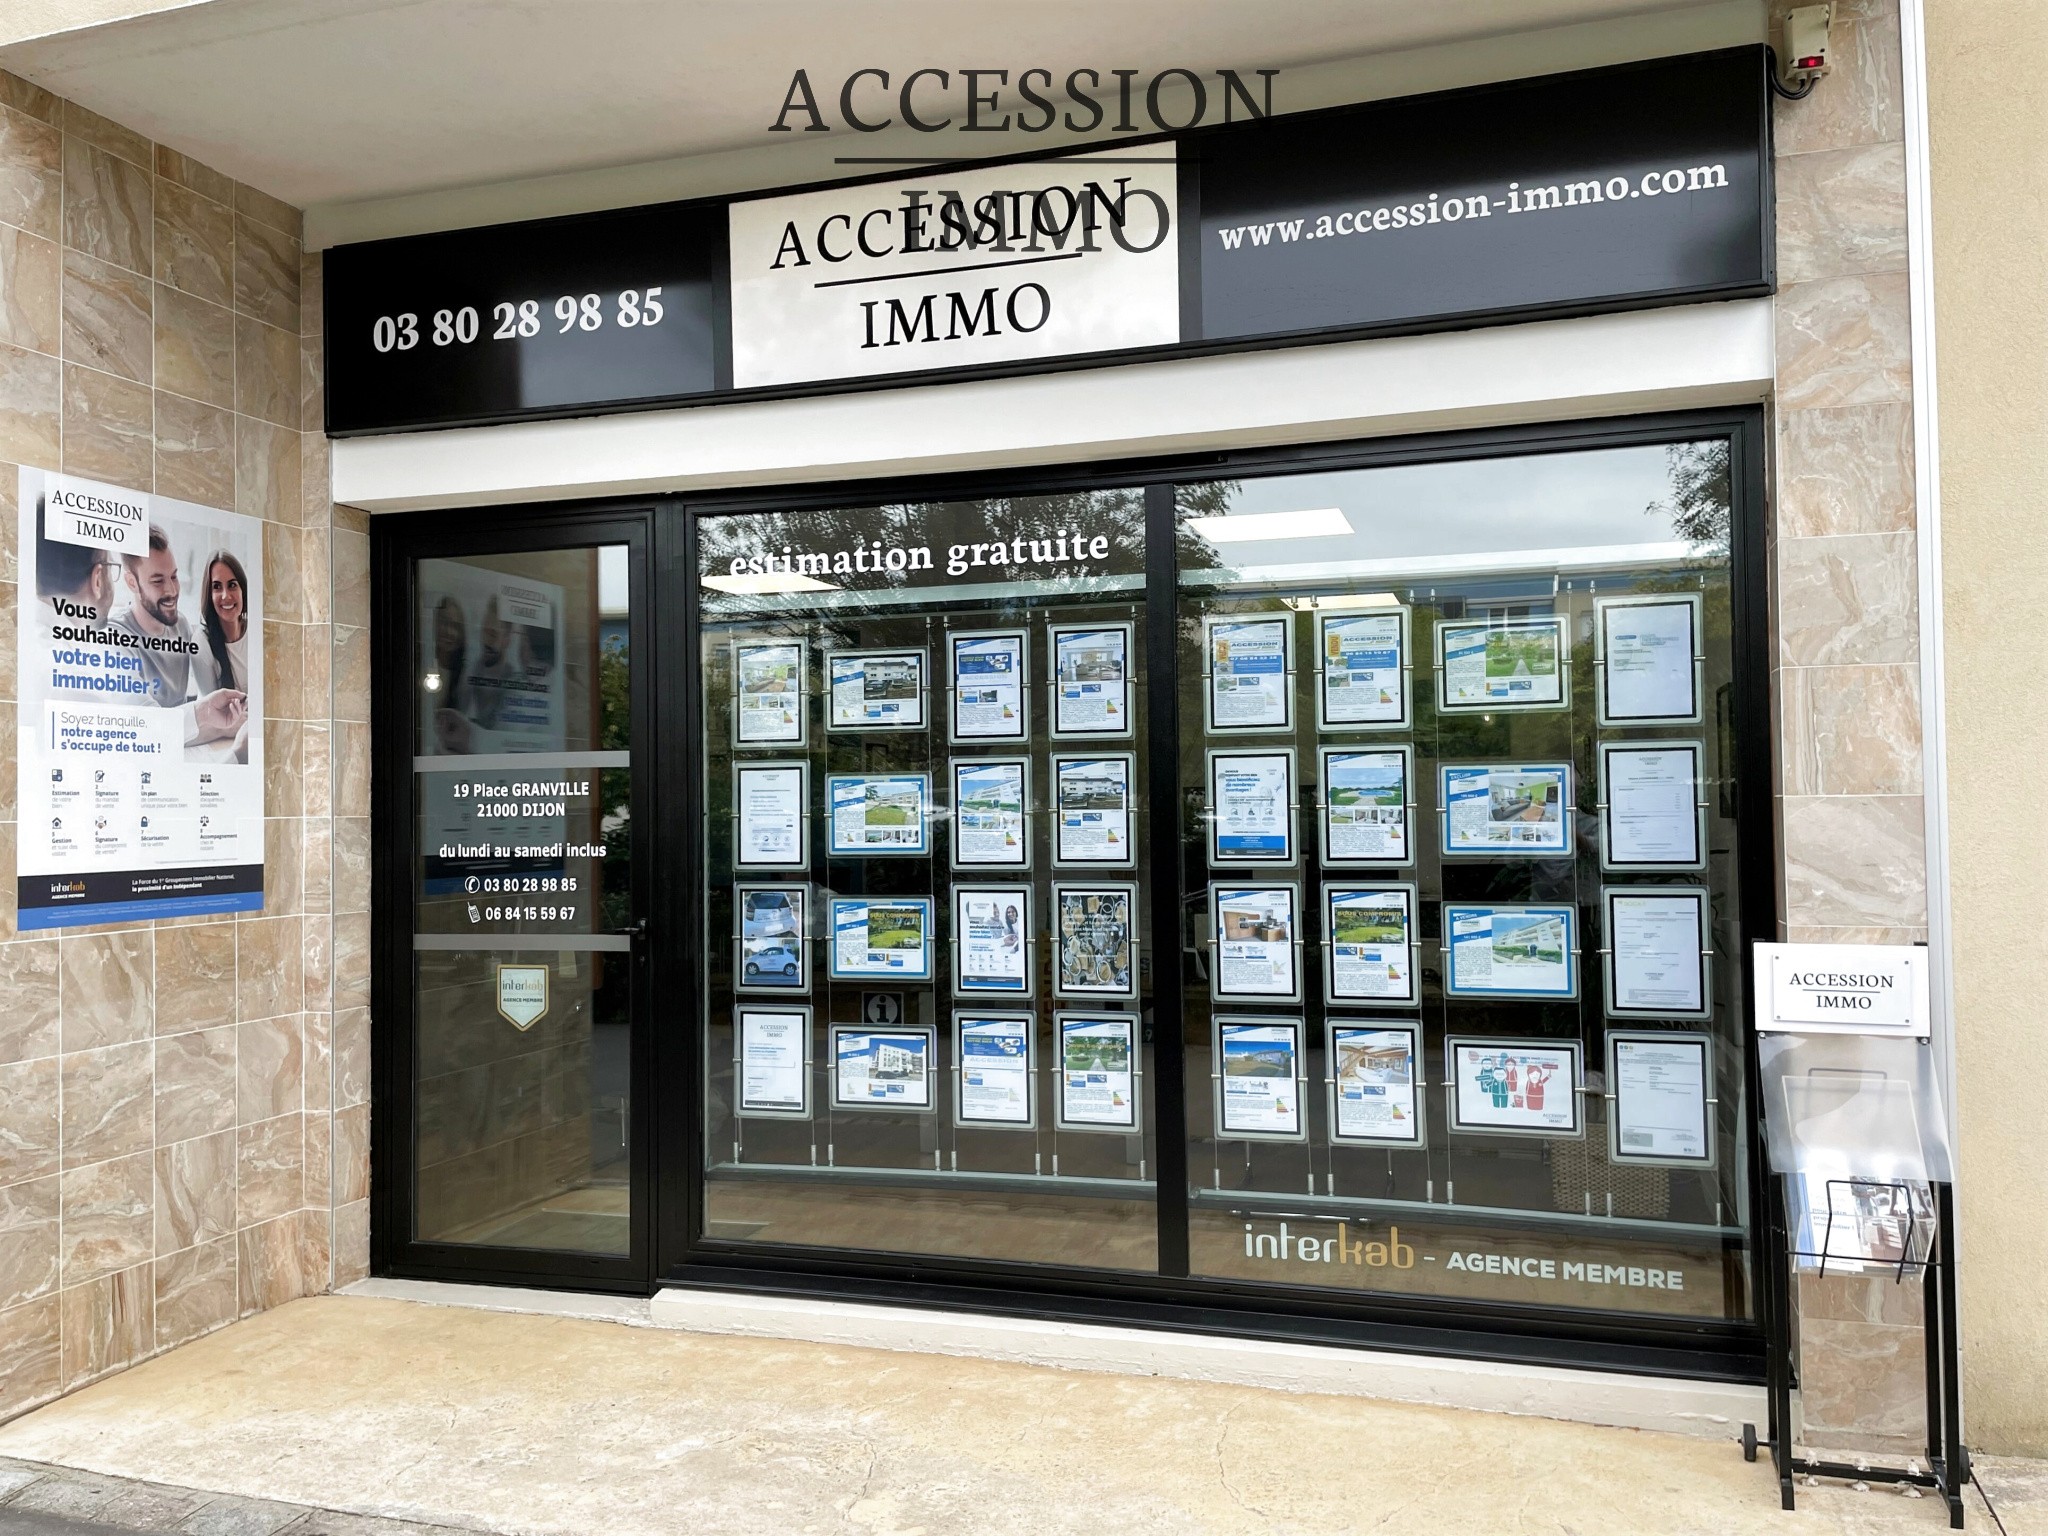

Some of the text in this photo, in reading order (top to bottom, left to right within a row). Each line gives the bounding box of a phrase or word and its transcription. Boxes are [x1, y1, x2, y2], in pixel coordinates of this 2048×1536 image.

[1218, 161, 1729, 253] www.accession-immo.com
[769, 175, 1134, 270] ACCESSION
[373, 285, 664, 355] 03 80 28 98 85
[860, 281, 1052, 349] IMMO
[52, 489, 143, 522] ACCESSION
[76, 520, 125, 543] IMMO
[730, 529, 1110, 577] estimation gratuite
[52, 596, 97, 620] Vous
[52, 624, 199, 655] souhaitez vendre
[52, 648, 142, 672] votre bien
[52, 669, 161, 695] immobilier ?
[61, 711, 147, 730] Soyez tranquille,
[61, 726, 137, 741] notre agence
[61, 739, 161, 754] s'occupe de tout !
[453, 781, 590, 798] 19 Place GRANVILLE
[477, 802, 565, 818] 21000 DIJON
[439, 842, 607, 858] du lundi au samedi inclus
[484, 877, 577, 892] 03 80 28 98 85
[485, 906, 575, 920] 06 84 15 59 67
[1789, 972, 1894, 988] ACCESSION
[1816, 995, 1872, 1010] IMMO
[1245, 1222, 1414, 1269] interkab
[1447, 1250, 1557, 1280] AGENCE
[1563, 1260, 1684, 1291] MEMBRE
